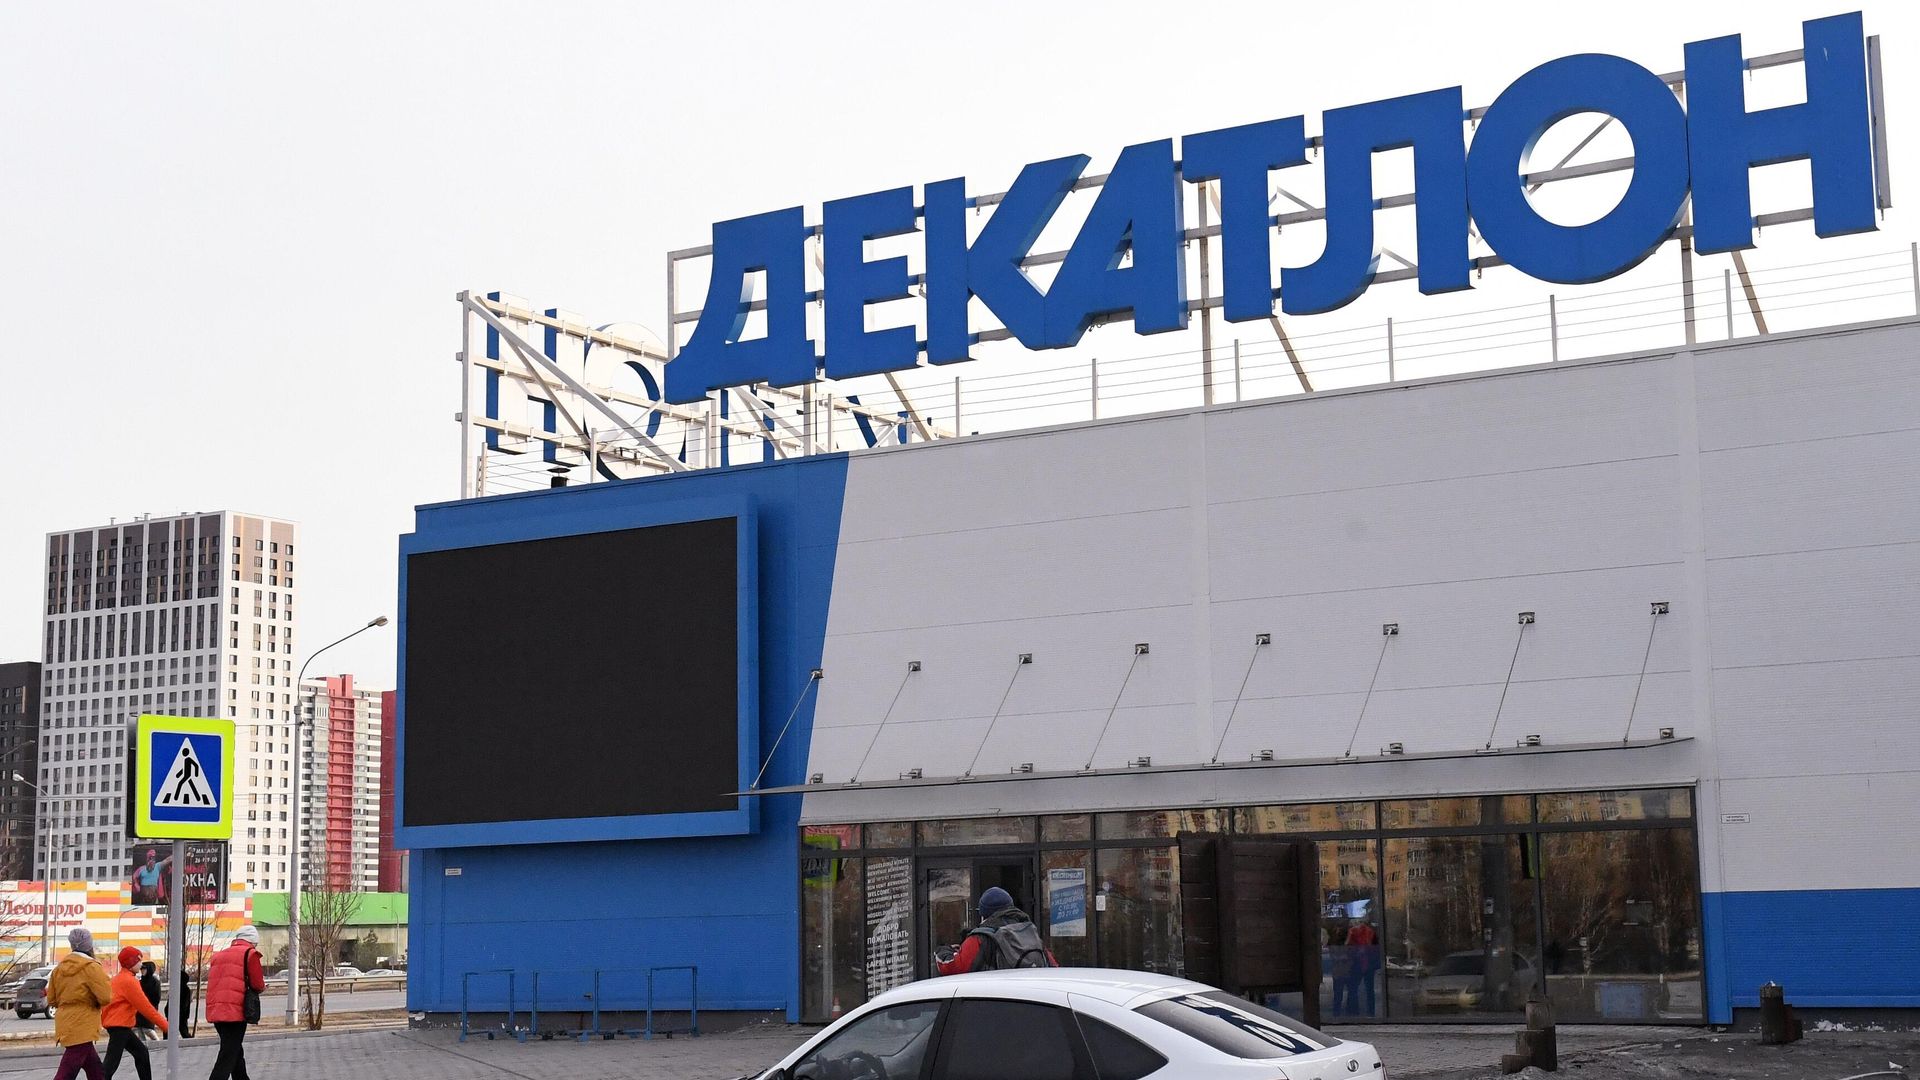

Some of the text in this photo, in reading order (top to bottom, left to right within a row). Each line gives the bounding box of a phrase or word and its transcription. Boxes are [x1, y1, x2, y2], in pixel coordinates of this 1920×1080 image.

[664, 12, 1876, 402] ДЕКАТЛОН
[879, 922, 899, 934] ДОБРО
[867, 930, 909, 945] ПОЖАЛОВАТЬ
